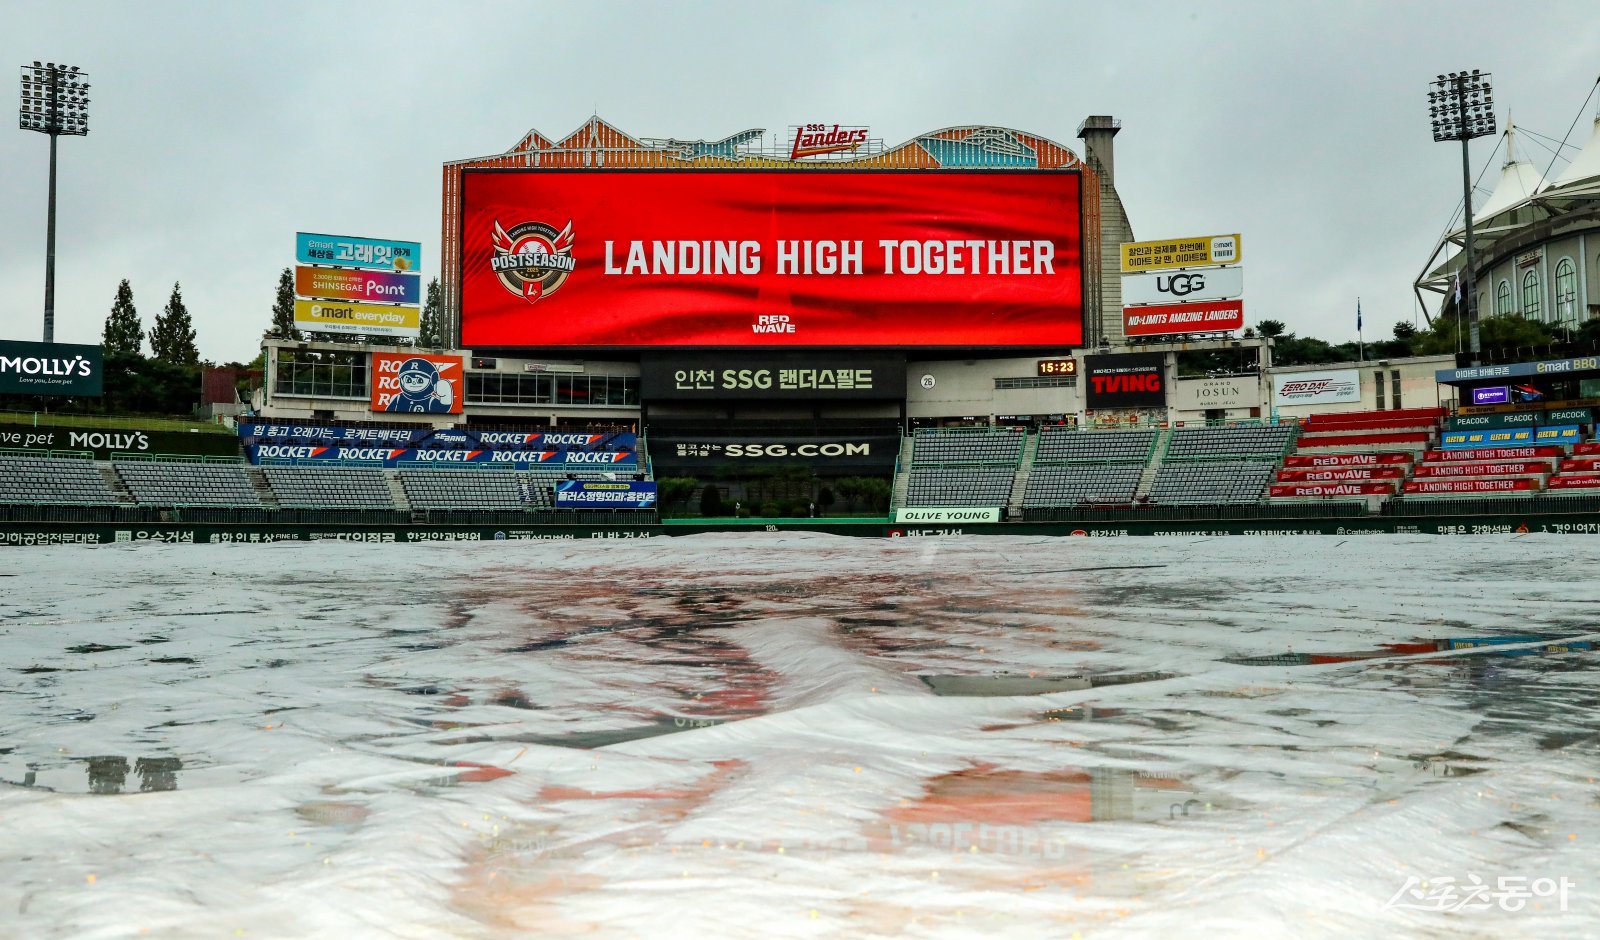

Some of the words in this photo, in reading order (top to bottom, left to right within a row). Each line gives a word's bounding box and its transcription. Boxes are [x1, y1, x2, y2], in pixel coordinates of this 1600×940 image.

[791, 124, 868, 159] Landers
[308, 240, 334, 249] emart
[336, 243, 392, 265] 고래잇
[604, 240, 761, 275] LANDING
[776, 240, 863, 275] HIGH
[879, 240, 1056, 275] TOGETHER
[491, 253, 576, 271] POSTSEASON
[1129, 257, 1152, 267] 이마트
[312, 281, 363, 292] SHINSEGAE
[366, 280, 405, 296] Point
[1157, 274, 1205, 296] UGG
[311, 305, 353, 319] emart
[355, 312, 405, 324] everyday
[758, 315, 790, 323] RED
[1169, 311, 1203, 323] AMAZING
[1204, 309, 1239, 320] LANDERS
[752, 323, 796, 333] WAVE
[0, 355, 91, 377] MOLLY'S
[410, 362, 419, 370] R
[1040, 362, 1074, 373] 15:23
[1537, 361, 1570, 373] emart
[1573, 358, 1597, 370] BBQ
[674, 369, 715, 390] 인천
[722, 369, 772, 390] SSG
[779, 369, 872, 390] 랜더스필드
[1455, 369, 1478, 379] 이마트
[924, 376, 933, 386] 26
[1091, 373, 1161, 394] TVING
[1281, 383, 1306, 393] ZERO
[1307, 381, 1329, 391] DAY
[1196, 387, 1240, 399] JOSUN
[1551, 410, 1586, 419] PEACOCK
[1457, 417, 1489, 425] PEACOCK
[253, 425, 264, 435] 힘
[267, 426, 289, 437] 좋고
[344, 428, 412, 441] 로케트배터리
[434, 433, 466, 442] SEBANG
[480, 433, 528, 445] ROCKET
[543, 433, 592, 445] ROCKET
[0, 432, 20, 443] ve
[23, 432, 55, 448] pet
[70, 431, 149, 450] MOLLY'S
[257, 445, 316, 458] ROCKET
[700, 443, 722, 451] 사는
[725, 443, 870, 457] SSG.COM
[338, 448, 395, 460] ROCKET
[416, 450, 472, 461] ROCKET
[491, 451, 547, 462] ROCKET
[565, 452, 619, 463] ROCKET
[1442, 451, 1475, 460] LANDING
[1476, 450, 1495, 458] HIGH
[1497, 448, 1536, 457] TOGETHER
[1313, 456, 1338, 466] RED
[1341, 455, 1377, 464] WAVE
[1306, 471, 1332, 480] RED
[1334, 470, 1371, 479] WAVE
[1431, 467, 1464, 476] LANDING
[1465, 466, 1484, 474] HIGH
[1486, 464, 1525, 473] TOGETHER
[1296, 486, 1322, 495] RED
[1324, 485, 1361, 494] WAVE
[1420, 483, 1452, 492] LANDING
[1454, 482, 1473, 490] HIGH
[1475, 481, 1514, 489] TOGETHER
[905, 512, 945, 520] OLIVE
[946, 511, 990, 520] YOUNG
